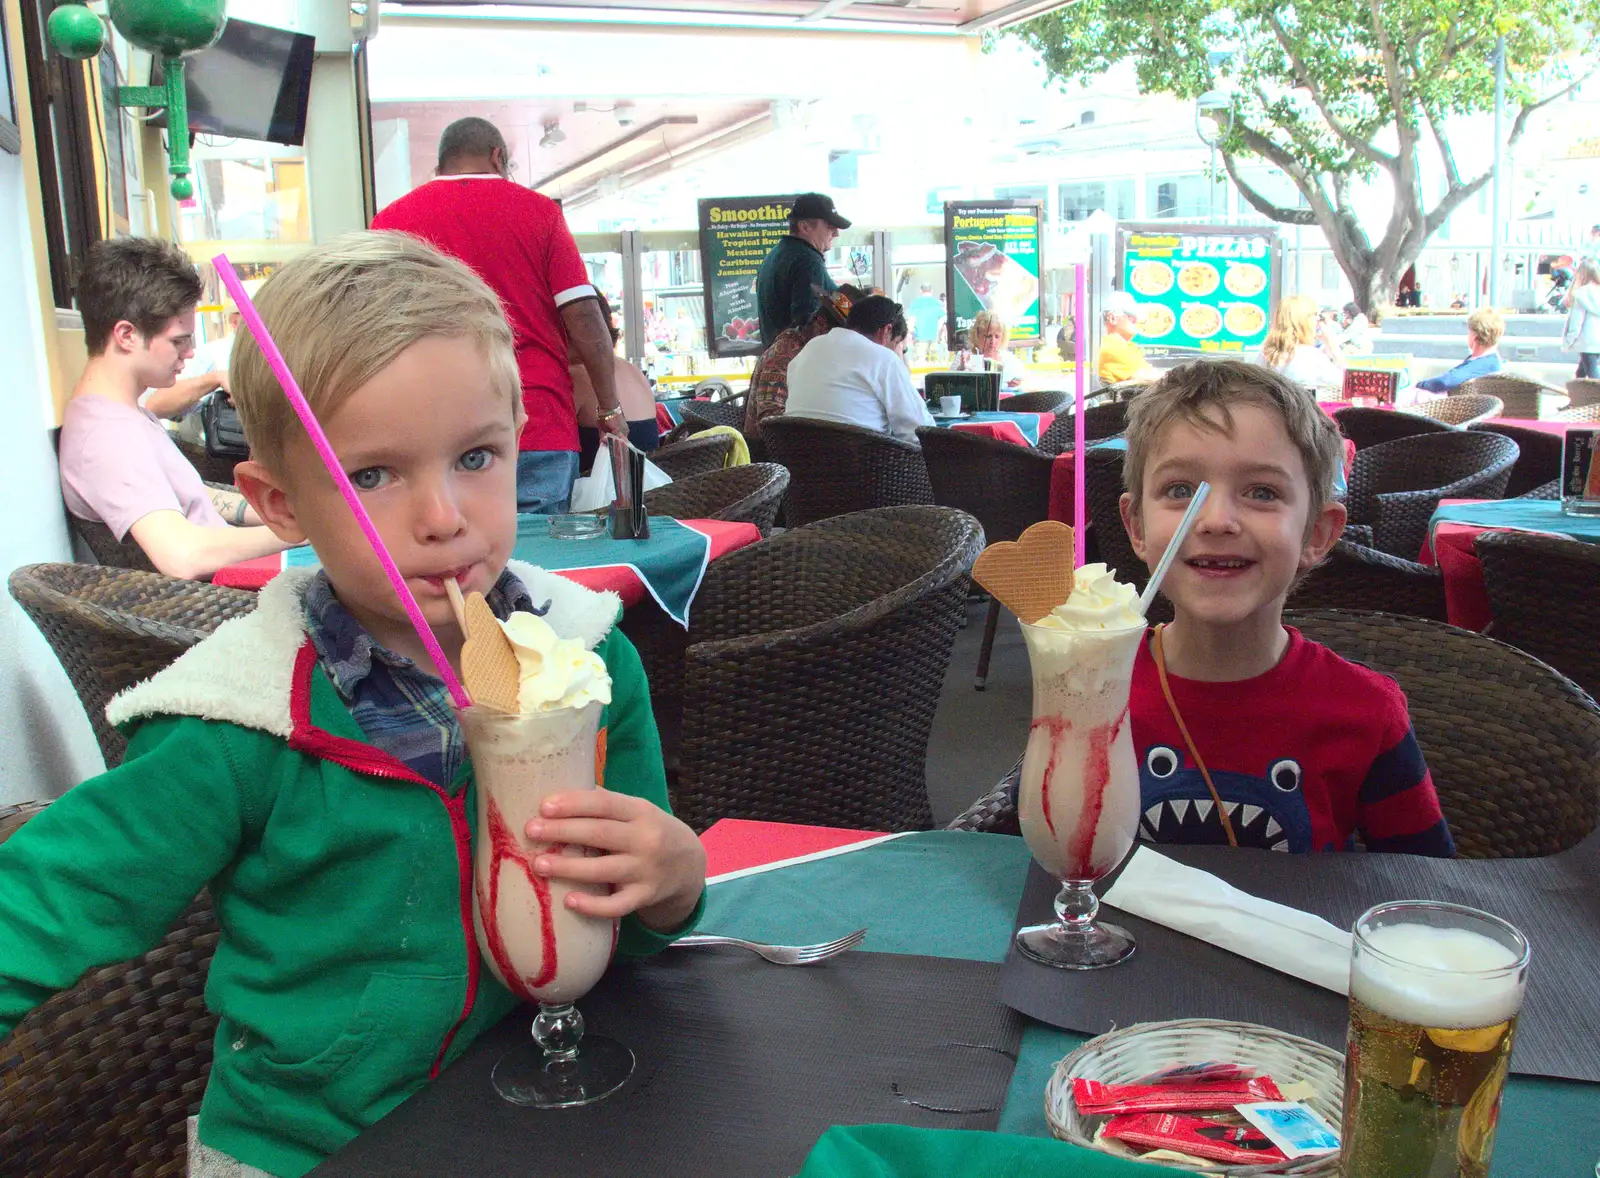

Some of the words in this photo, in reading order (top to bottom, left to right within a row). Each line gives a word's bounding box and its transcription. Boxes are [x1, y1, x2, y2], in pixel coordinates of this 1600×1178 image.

[716, 230, 759, 239] Hawaiian
[722, 238, 760, 247] Tropical
[1181, 236, 1266, 258] PIZZAS
[727, 248, 764, 257] Mexican
[717, 268, 757, 277] Jamaican
